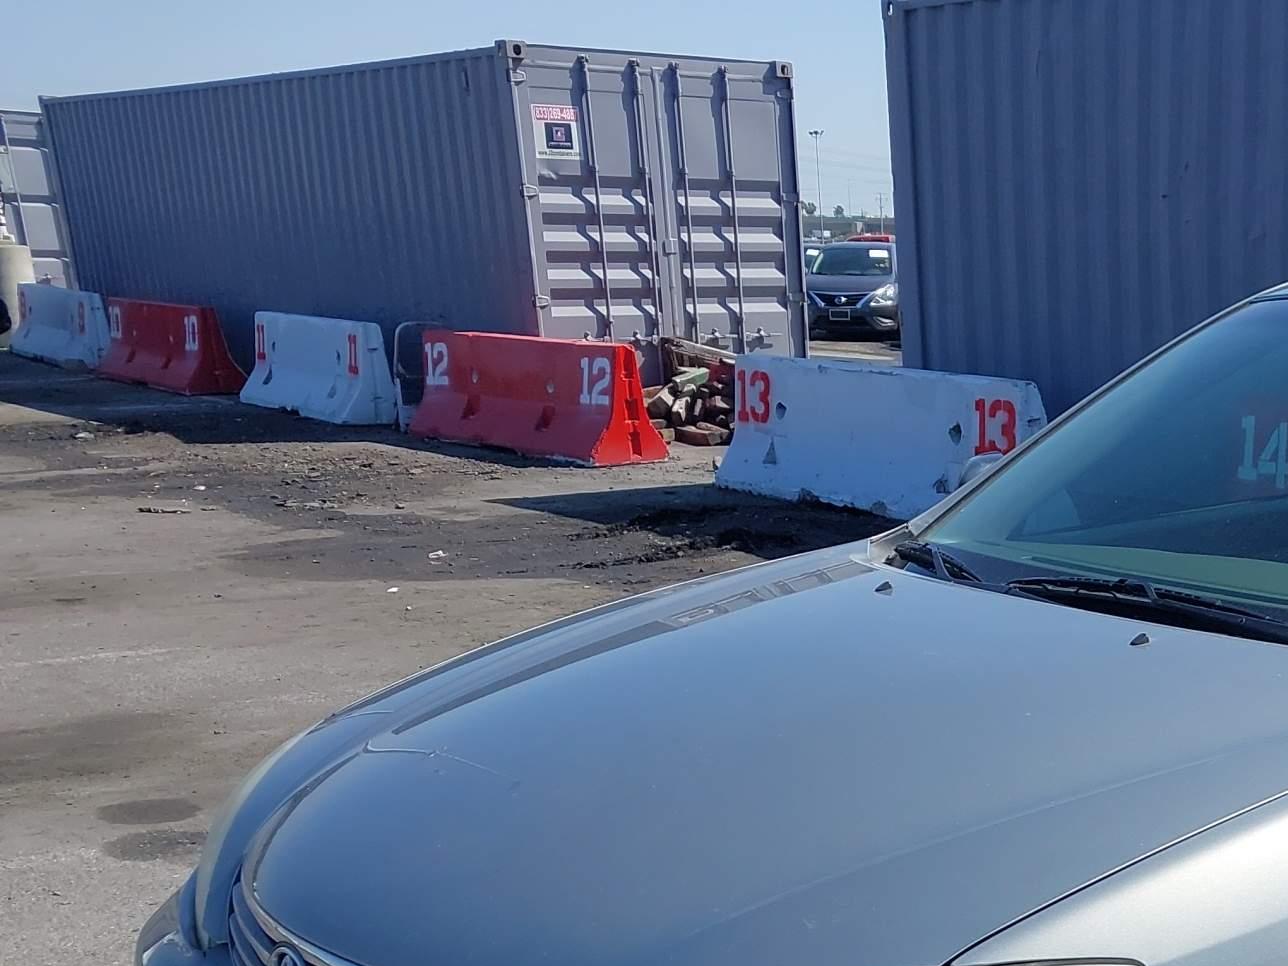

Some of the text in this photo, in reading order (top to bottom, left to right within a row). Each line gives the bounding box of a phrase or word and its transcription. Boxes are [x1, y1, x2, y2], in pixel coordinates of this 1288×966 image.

[109, 304, 122, 338] 10
[184, 315, 199, 351] 10
[256, 324, 267, 361] 11
[347, 334, 359, 376] 11
[424, 342, 449, 385] 12
[579, 356, 611, 405] 12
[737, 369, 771, 424] 13
[974, 398, 1017, 456] 13
